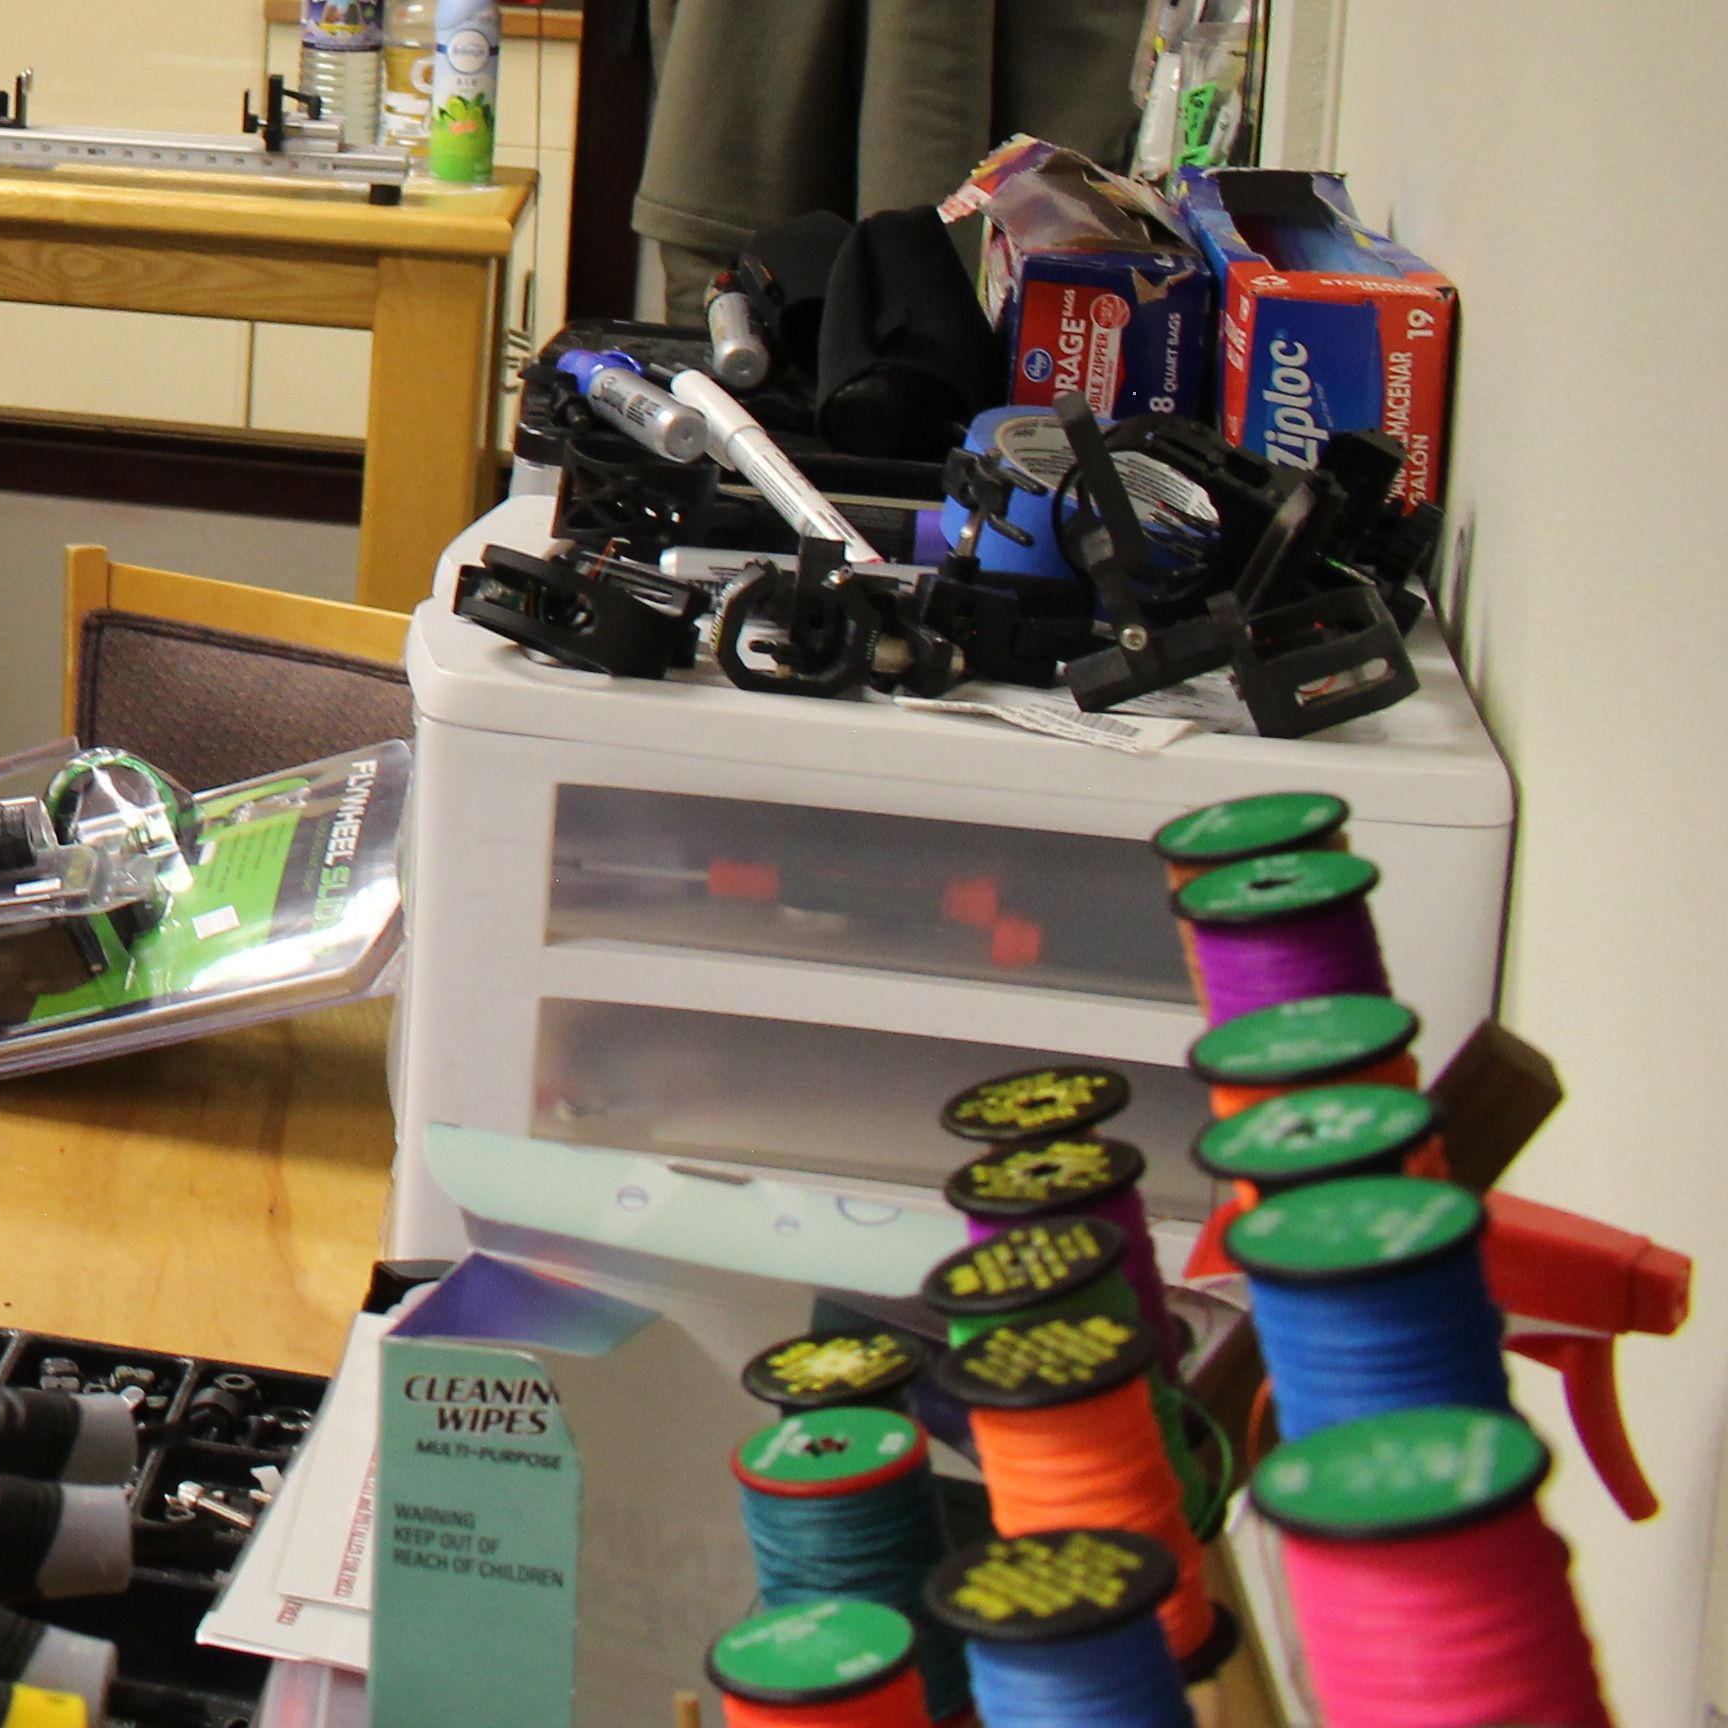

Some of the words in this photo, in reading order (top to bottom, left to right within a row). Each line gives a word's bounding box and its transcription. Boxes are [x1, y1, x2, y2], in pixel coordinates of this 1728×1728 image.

[1166, 311, 1183, 347] BAGS
[1406, 308, 1435, 340] 19
[1163, 348, 1181, 393] QUART
[1262, 339, 1331, 475] Ziploc
[323, 758, 378, 866] FLYWHEEL
[437, 1406, 549, 1435] WIPES
[416, 1438, 563, 1470] MULTI-PURPOSE
[394, 1503, 476, 1529] WARNING
[394, 1525, 436, 1546] KEEP
[440, 1531, 473, 1551] OUT
[393, 1546, 449, 1569] REACH
[479, 1560, 564, 1588] CHILDREN
